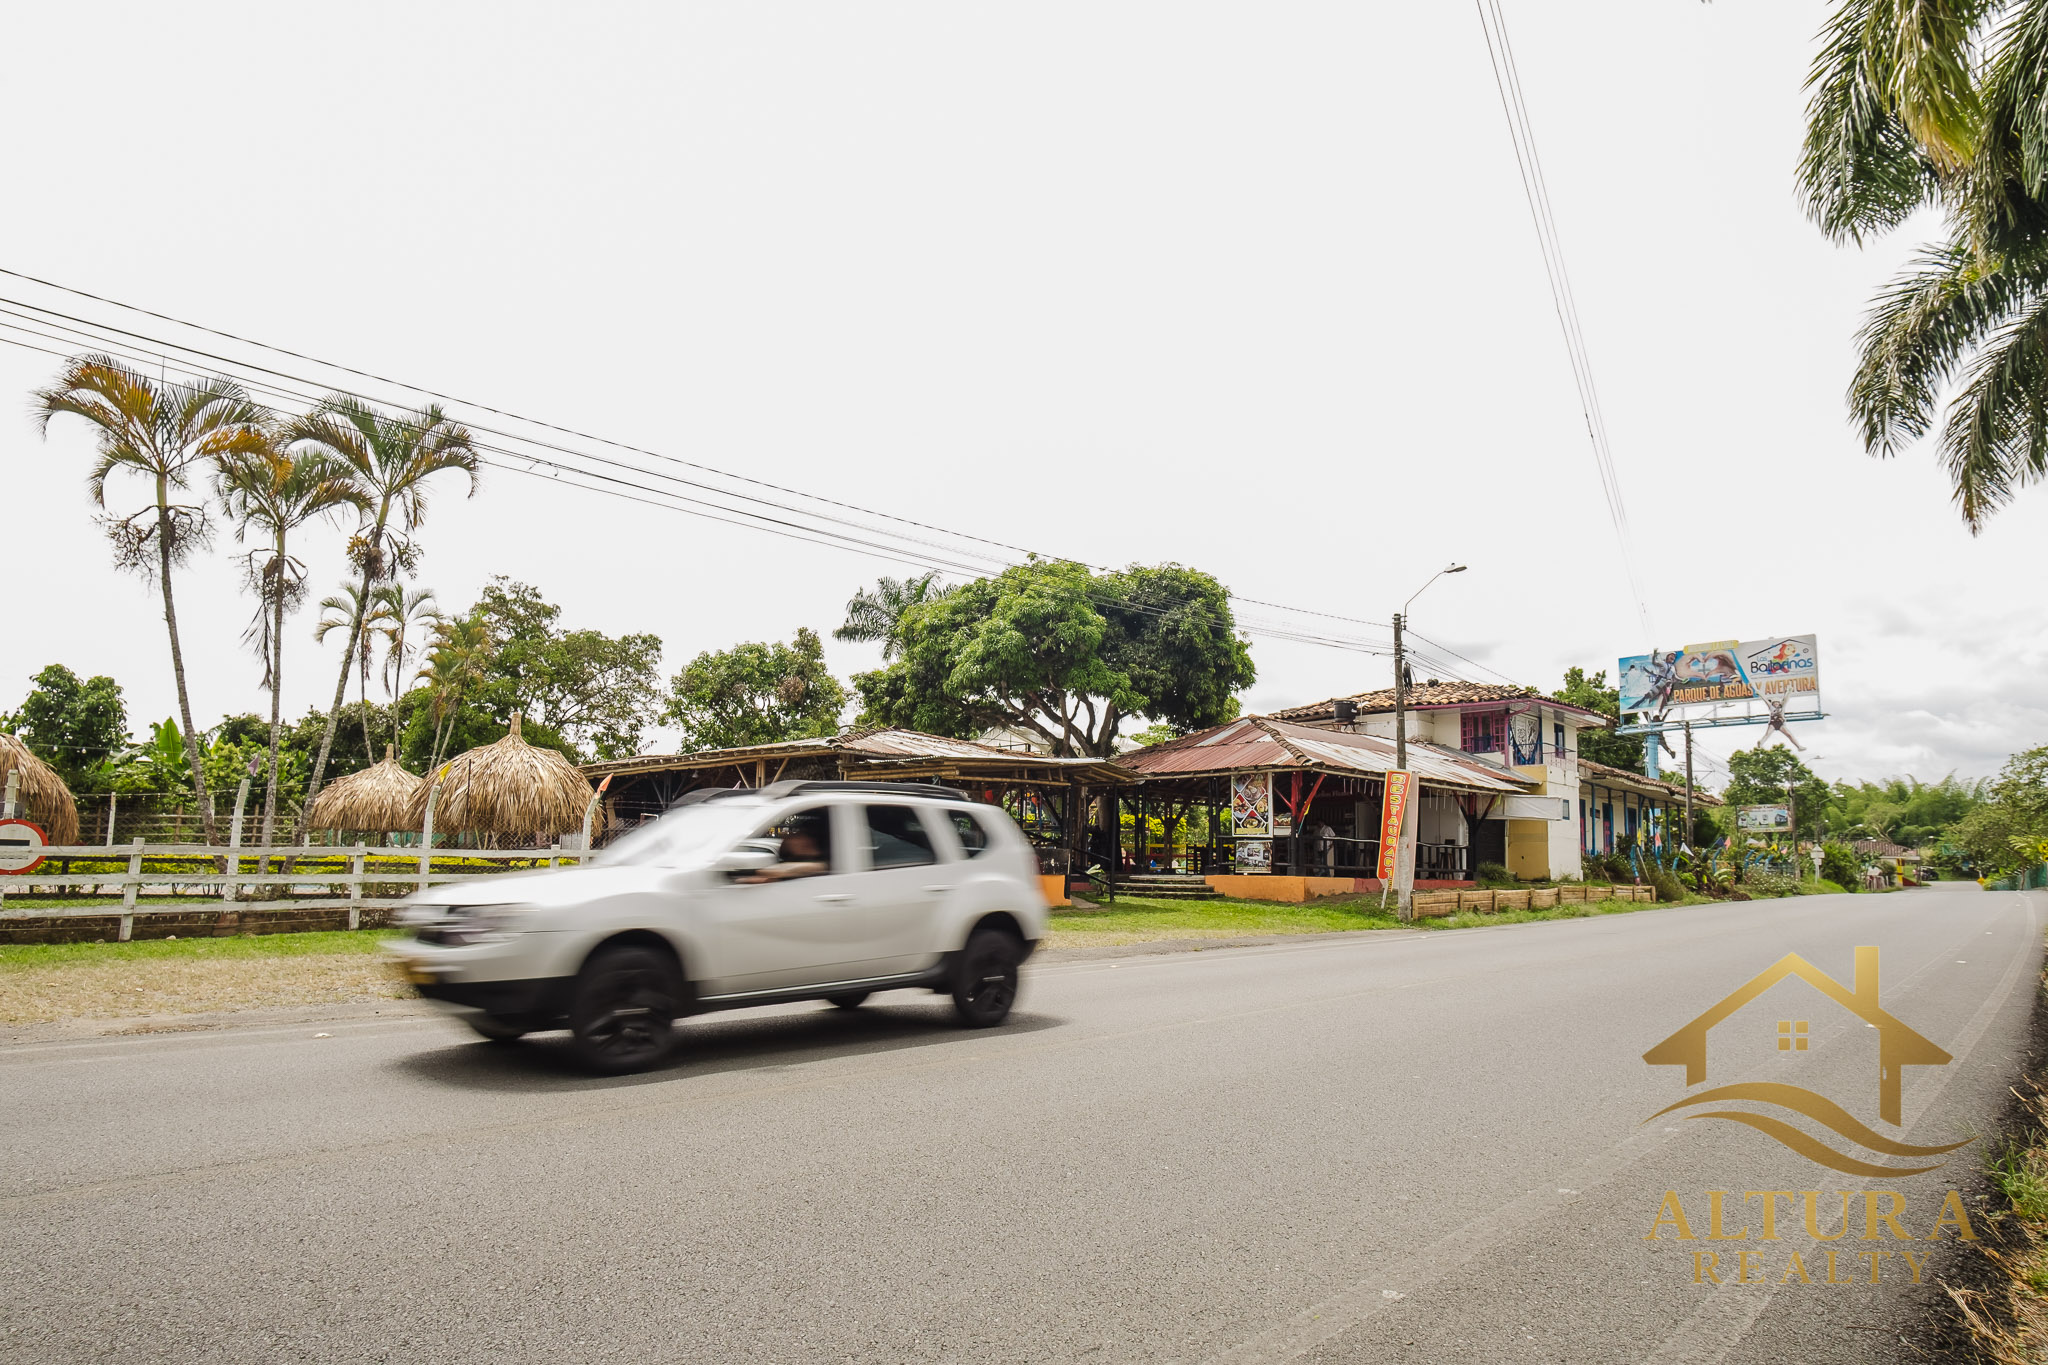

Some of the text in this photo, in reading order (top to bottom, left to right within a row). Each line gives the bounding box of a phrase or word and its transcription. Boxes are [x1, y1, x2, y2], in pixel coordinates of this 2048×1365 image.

[1674, 687, 1707, 703] PARQUE
[1709, 685, 1721, 699] DE
[1724, 683, 1753, 698] AGUAS
[1765, 676, 1817, 695] AVENTURA
